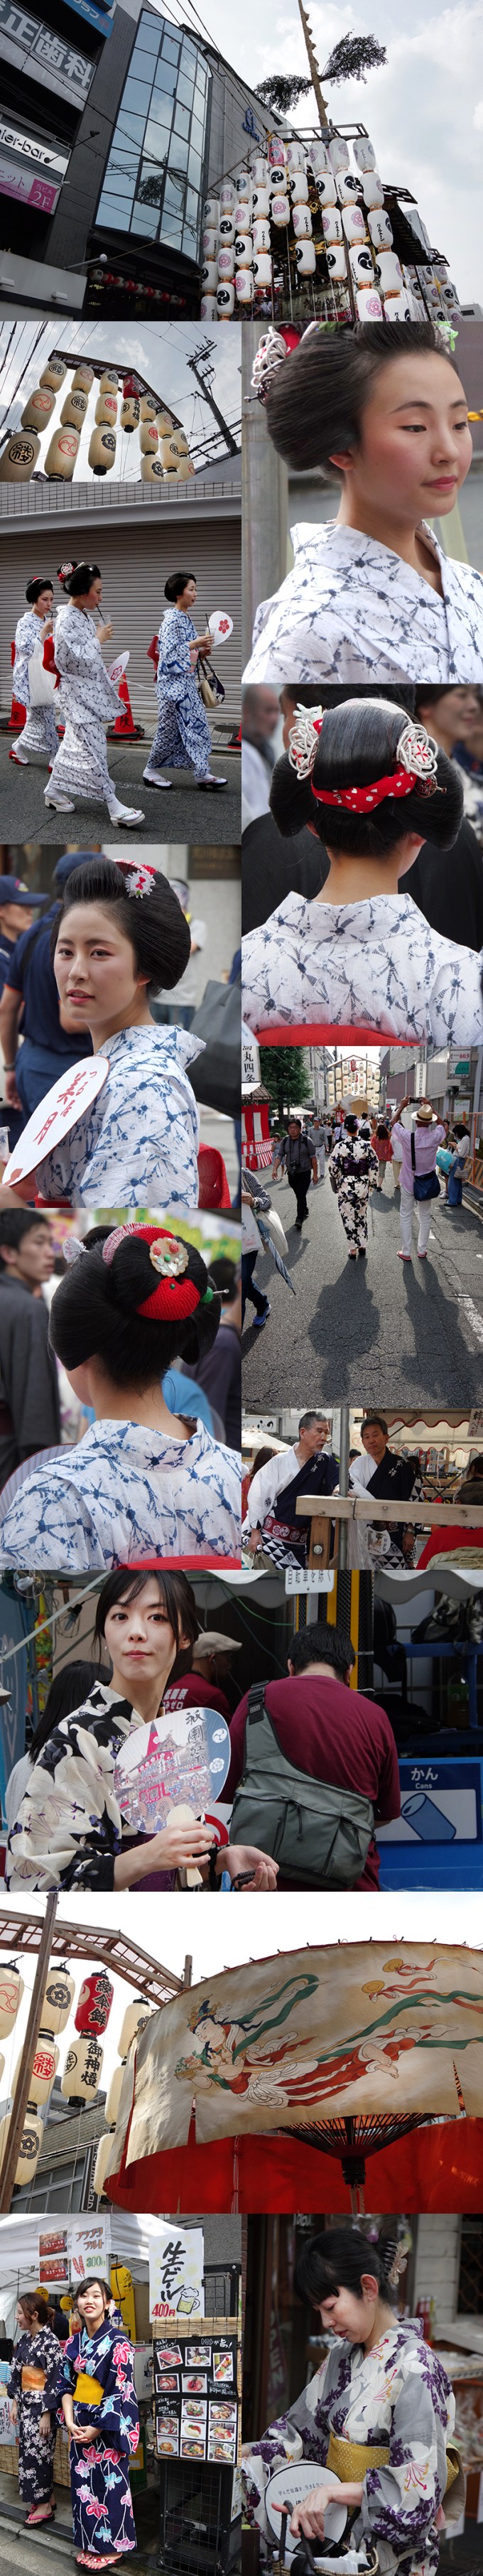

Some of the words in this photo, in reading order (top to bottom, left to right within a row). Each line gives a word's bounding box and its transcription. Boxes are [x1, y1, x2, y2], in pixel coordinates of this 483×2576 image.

[0, 1, 92, 87] 正歯科
[0, 128, 45, 159] ier-bar
[31, 191, 50, 208] 2F
[185, 1709, 206, 1764] 祇園祭
[411, 1767, 438, 1781] かん
[89, 1979, 114, 2027] 綾傘鉾
[81, 2042, 103, 2089] 御神燈
[83, 2239, 104, 2251] フルト
[160, 2241, 186, 2302] 生ビール
[151, 2303, 175, 2317] 400円
